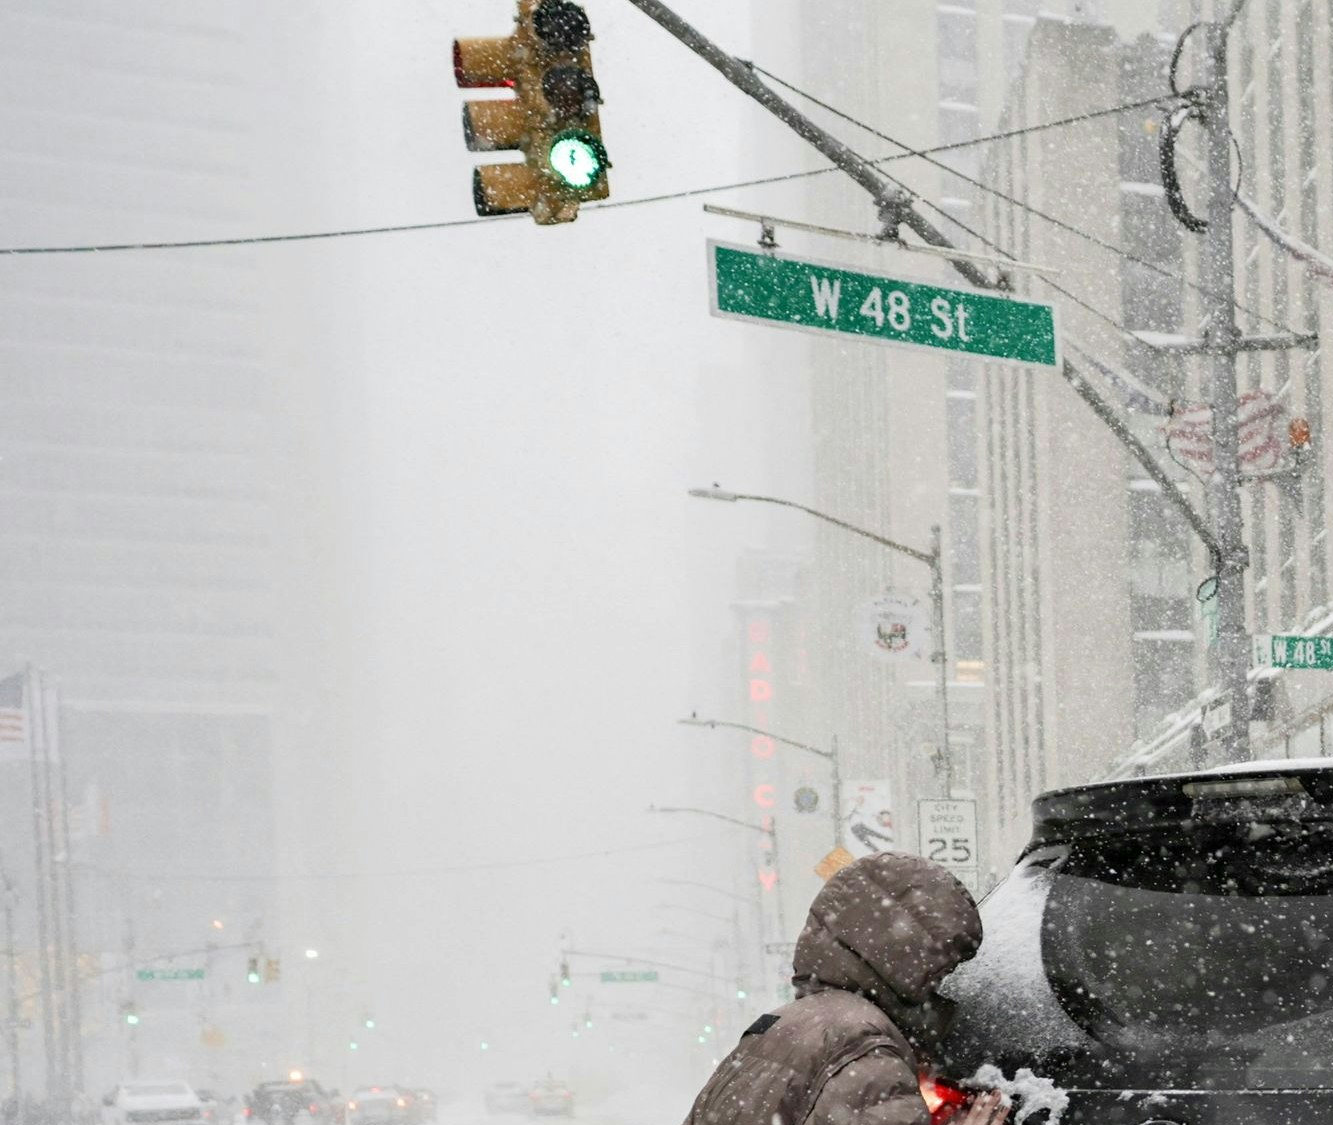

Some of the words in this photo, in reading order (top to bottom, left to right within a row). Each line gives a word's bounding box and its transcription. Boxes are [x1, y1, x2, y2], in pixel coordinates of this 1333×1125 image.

[810, 274, 842, 323] W
[859, 286, 911, 332] 48
[930, 297, 972, 343] St
[1274, 639, 1287, 664] W
[1293, 640, 1317, 665] 48
[1320, 639, 1332, 655] St
[930, 814, 964, 823] SPEED
[933, 825, 960, 833] LIMIT
[753, 783, 779, 892] CIY
[928, 838, 971, 862] 25
